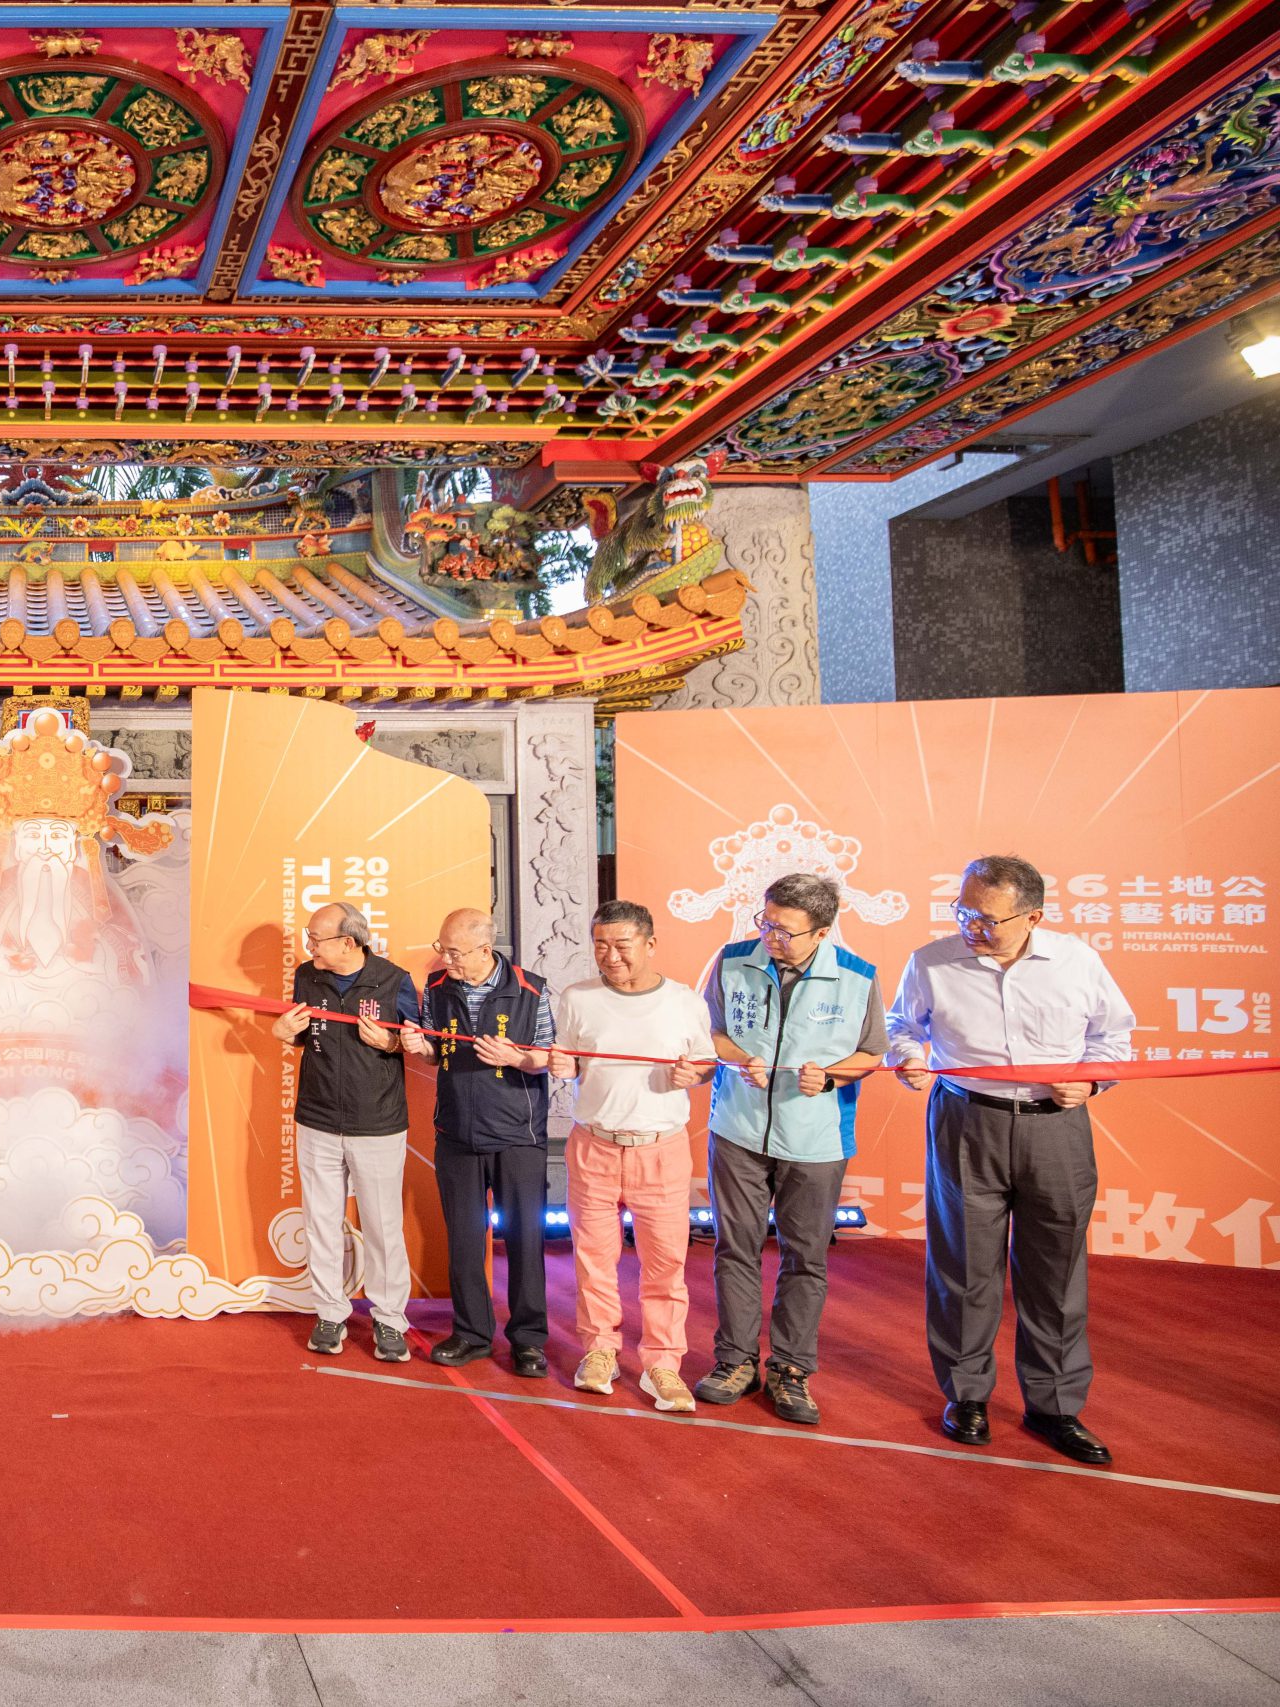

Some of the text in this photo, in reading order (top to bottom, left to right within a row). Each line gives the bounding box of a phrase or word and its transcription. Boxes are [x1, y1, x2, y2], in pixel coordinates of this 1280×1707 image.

[344, 856, 390, 876] 20
[344, 877, 390, 898] 26
[929, 902, 1267, 926] 國民俗藝術節
[282, 857, 296, 1002] INTERNATIONAL
[1122, 931, 1235, 942] INTERNATIONAL
[1122, 943, 1268, 955] FOLK ARTS FESTIVAL
[1166, 987, 1272, 1035] 13 SUN
[21, 1063, 76, 1081] GONG
[281, 1062, 295, 1109] ARTS
[280, 1113, 295, 1200] FESTIVAL
